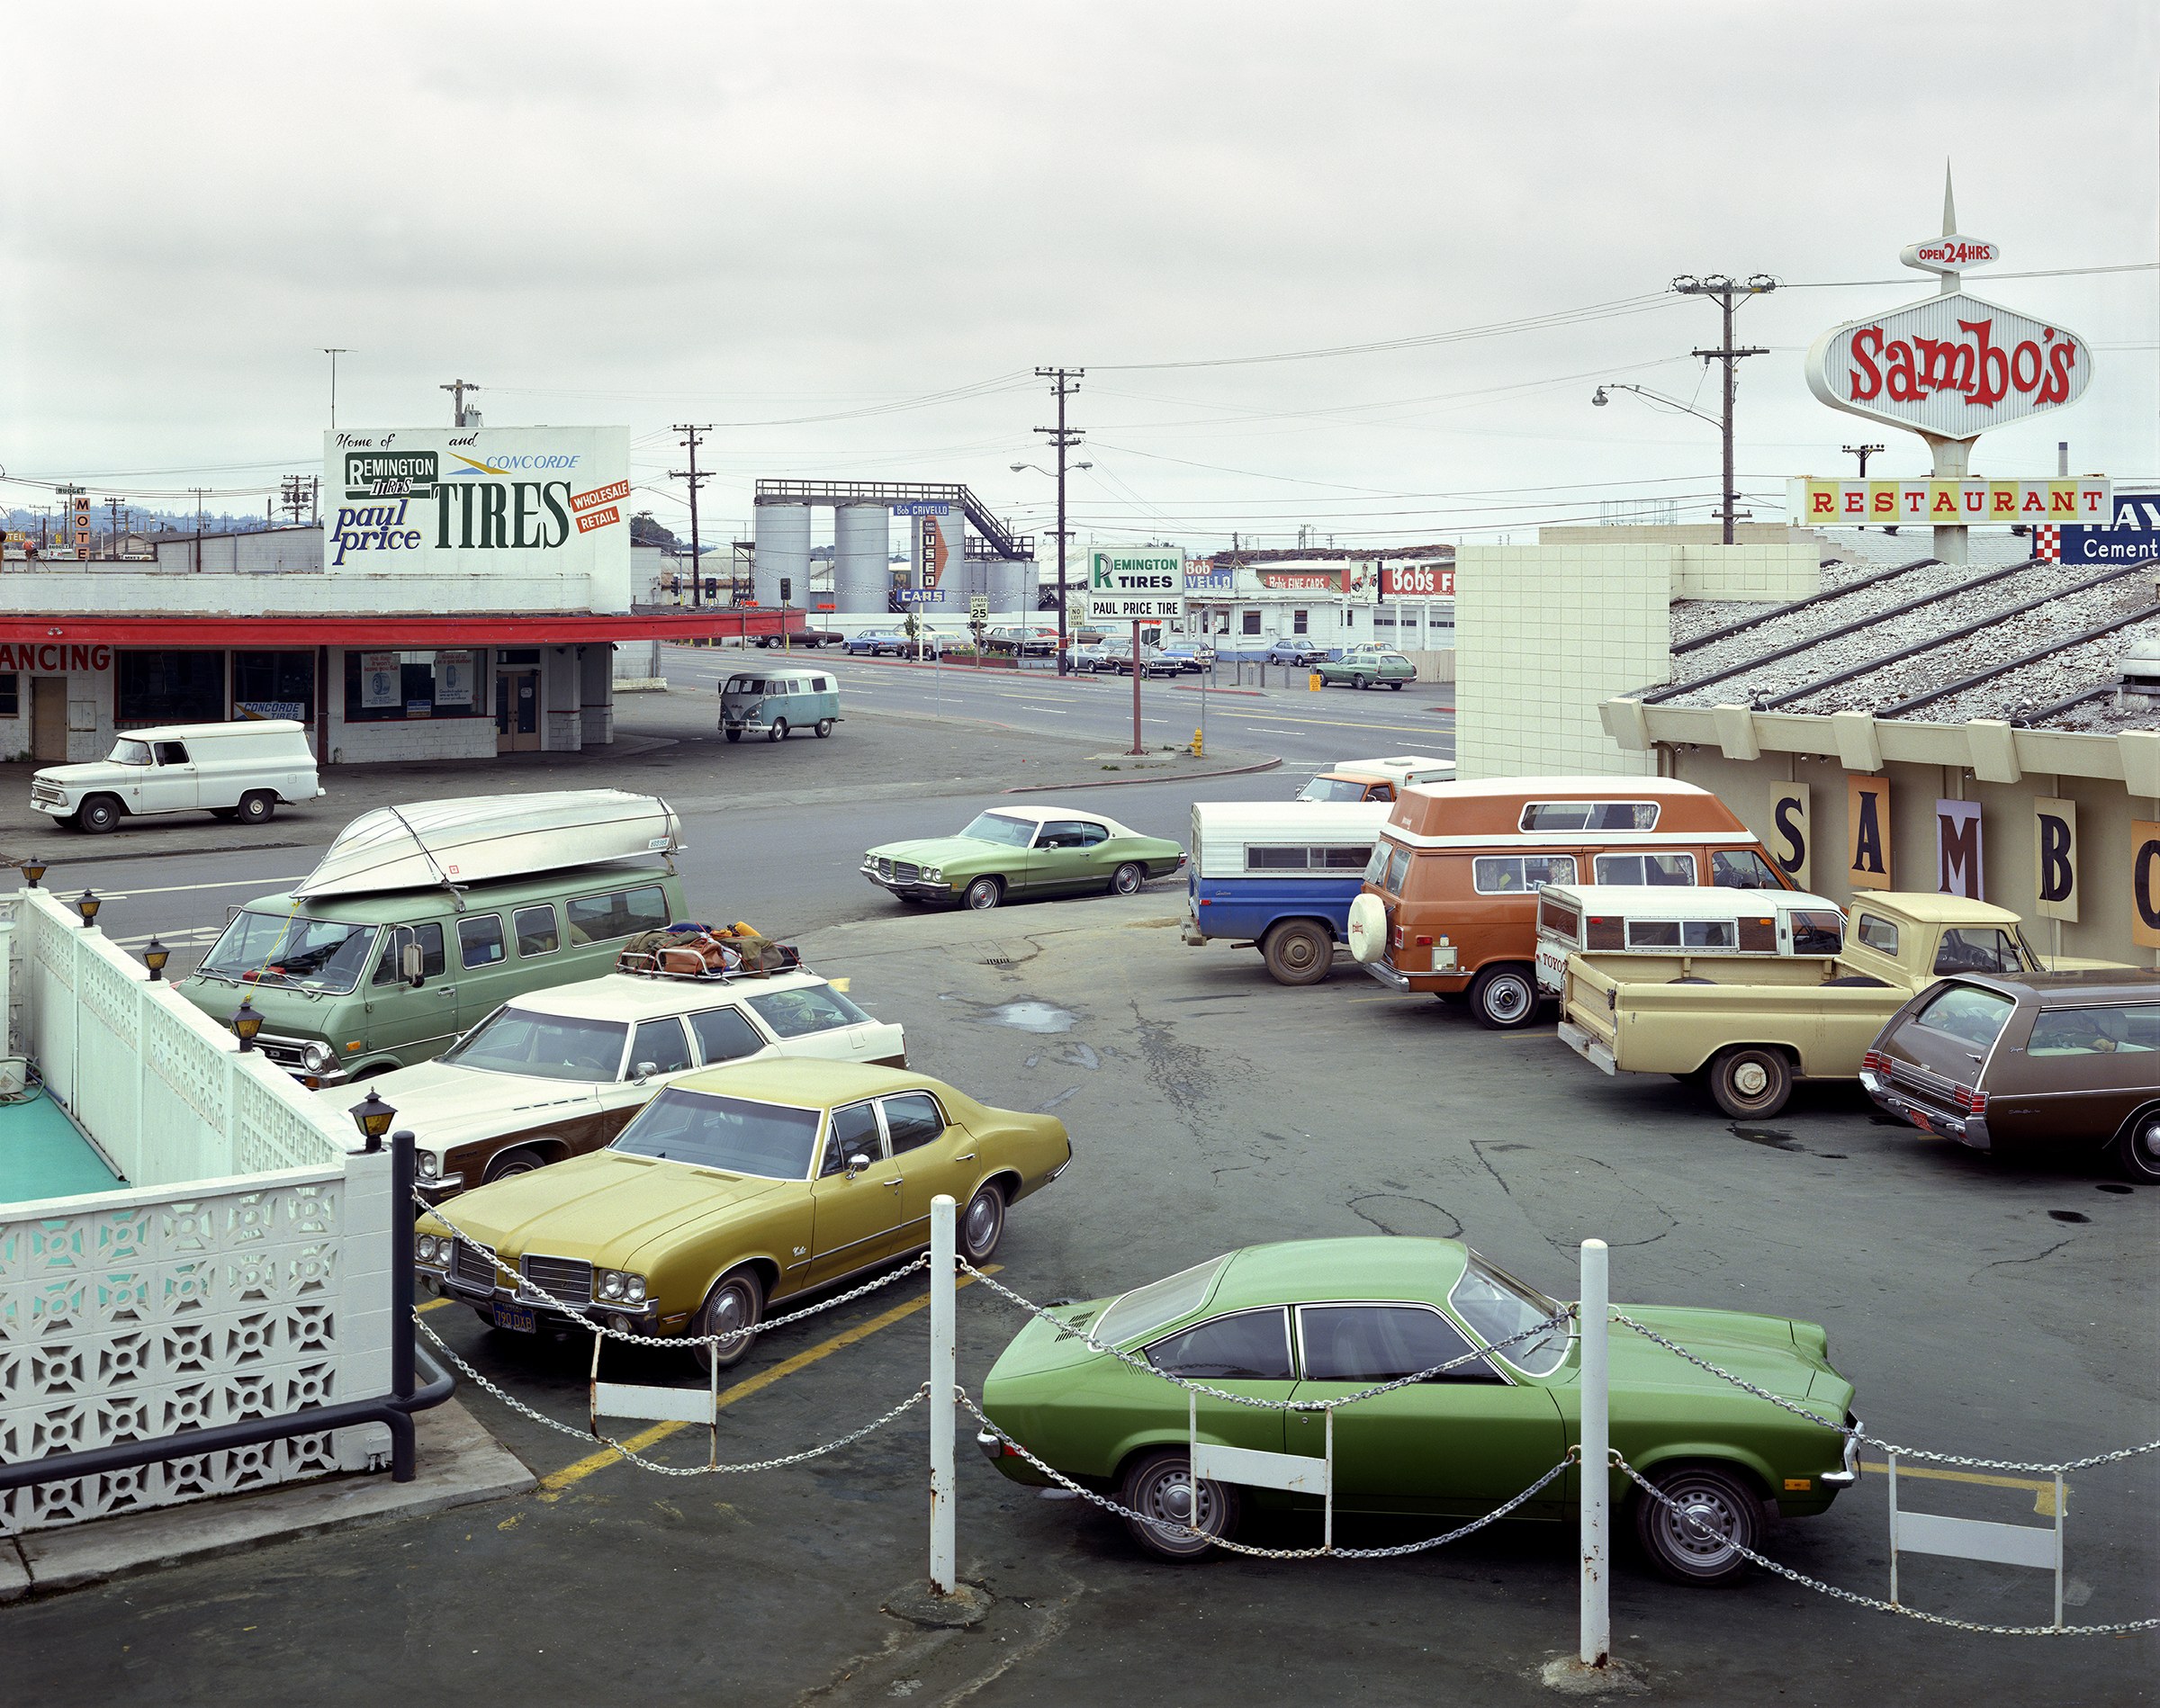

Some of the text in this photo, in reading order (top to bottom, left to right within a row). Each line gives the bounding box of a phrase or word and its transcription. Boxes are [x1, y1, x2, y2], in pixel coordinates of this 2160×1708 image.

[1919, 243, 1993, 262] OPEN 24 HRS.
[1850, 319, 2076, 409] Sambo's
[336, 433, 479, 450] Home of and
[349, 459, 434, 484] REMINGTON
[486, 455, 580, 469] CONCORDE
[370, 478, 413, 495] TIRES
[573, 480, 627, 510] WHOLESALE
[896, 505, 947, 515] Bob CRIVELLO
[1814, 491, 2102, 513] RESTAURANT
[329, 498, 410, 542] paul
[431, 481, 571, 550] TIRES
[580, 511, 616, 530] RETAIL
[2084, 503, 2160, 531] AY
[332, 526, 421, 565] price
[2084, 538, 2158, 558] Cement
[925, 535, 935, 586] USED
[1094, 553, 1178, 588] REMINGTON
[1185, 562, 1210, 574] Bob
[1119, 576, 1173, 589] TIRES
[1389, 560, 1455, 591] Bob's F
[901, 591, 943, 602] CARS
[972, 609, 986, 618] 25
[1094, 602, 1178, 615] PAUL PRICE TIRE
[0, 644, 111, 670] ANCING
[244, 703, 299, 713] CONCORDE
[496, 1310, 532, 1330] 790 DXB
